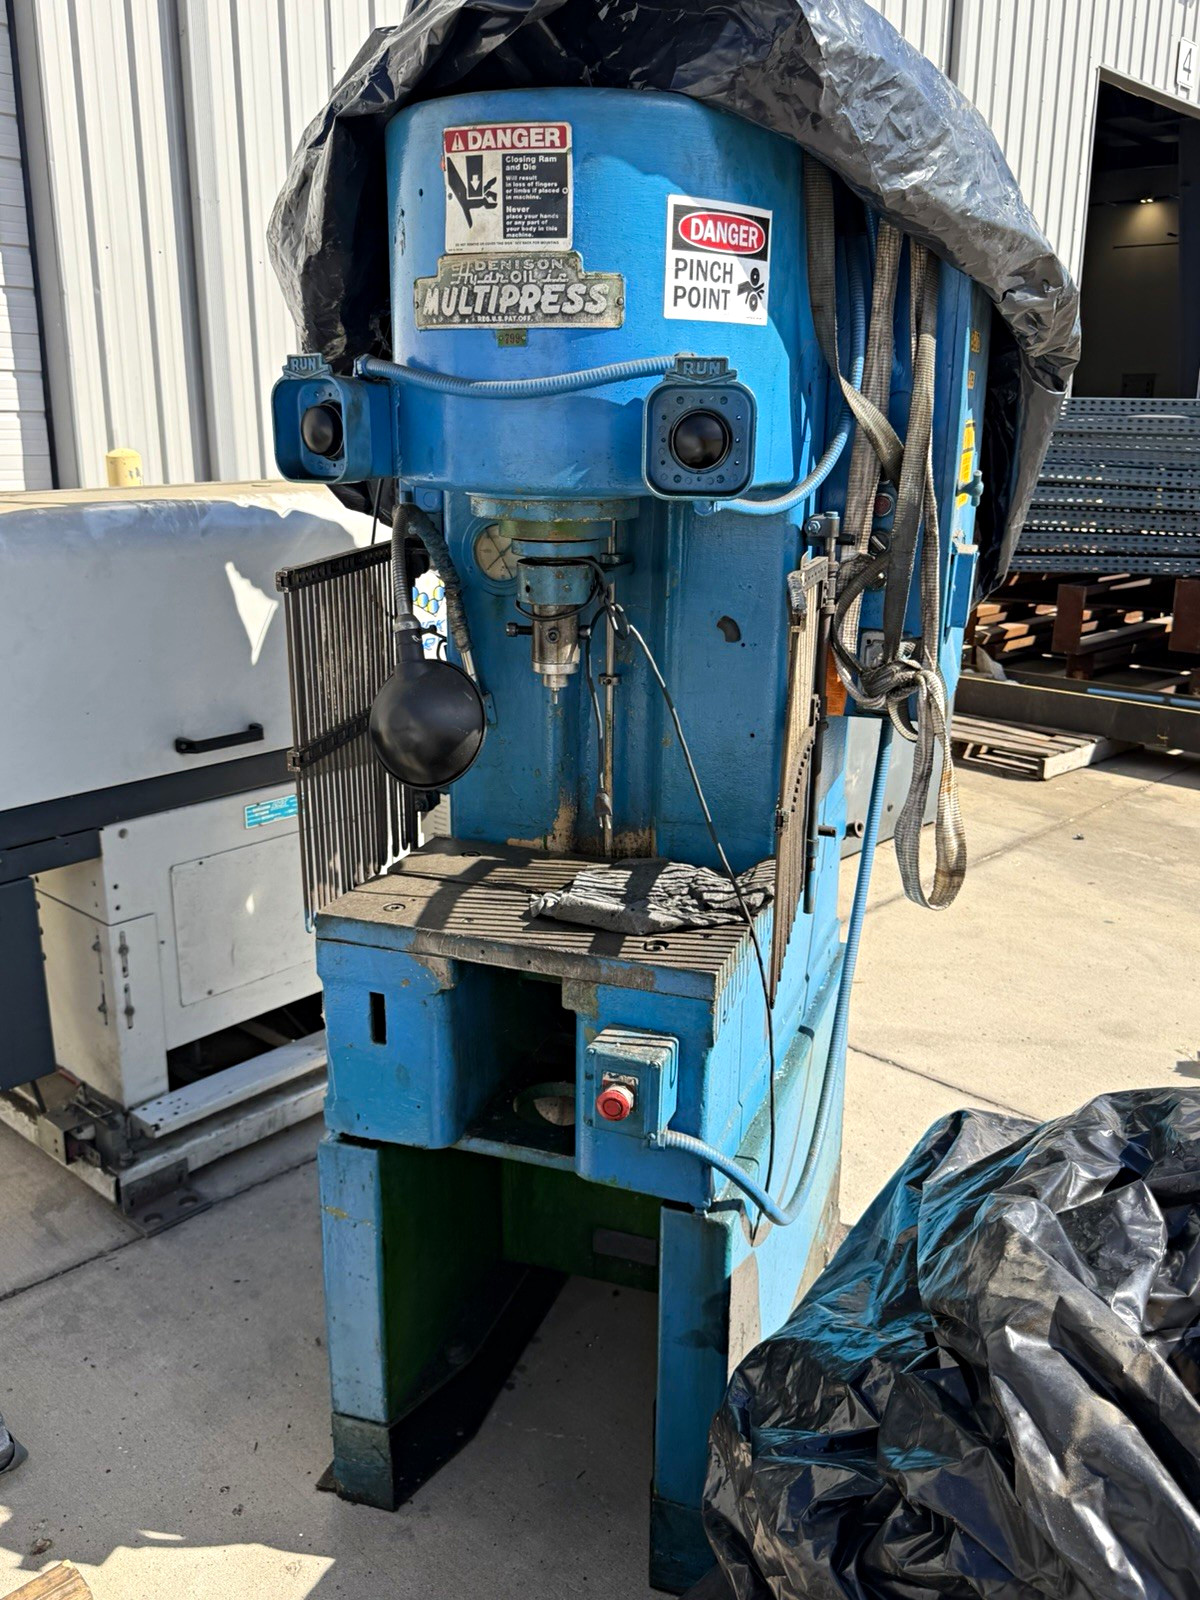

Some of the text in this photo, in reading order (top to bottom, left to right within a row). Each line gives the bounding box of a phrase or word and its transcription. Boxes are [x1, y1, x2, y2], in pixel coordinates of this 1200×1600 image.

[1182, 47, 1193, 81] 4
[467, 127, 561, 151] DANGER
[505, 155, 536, 164] Closing
[522, 163, 537, 171] Die
[505, 205, 530, 213] Never
[690, 217, 759, 249] DANGER
[474, 259, 563, 271] DENISON
[674, 257, 733, 284] PINCH
[422, 283, 610, 316] MULTIPRESS
[673, 285, 730, 310] POINT
[290, 357, 317, 371] RUN
[683, 361, 720, 375] RUN
